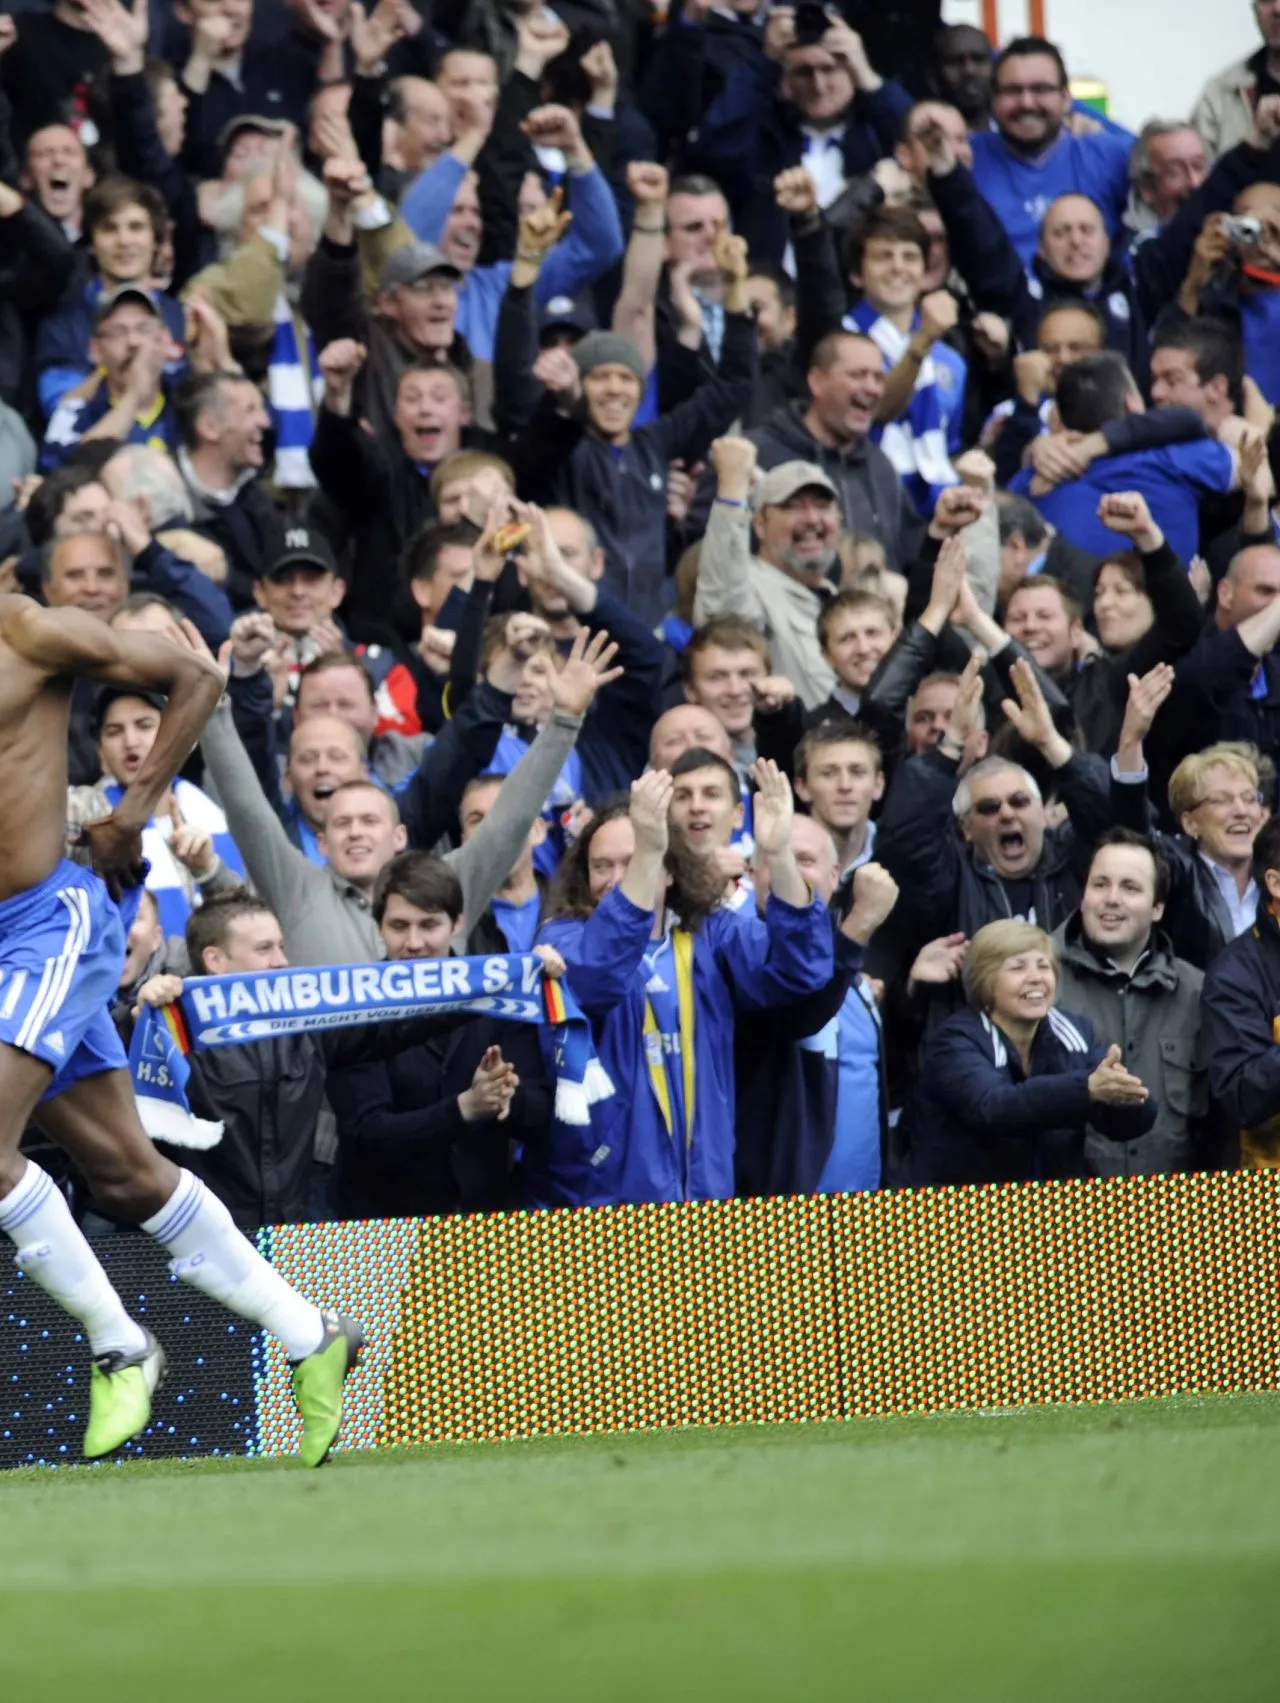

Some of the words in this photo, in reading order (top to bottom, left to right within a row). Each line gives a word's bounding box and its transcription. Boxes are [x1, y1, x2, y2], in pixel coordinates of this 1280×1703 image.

[191, 958, 471, 1023] HAMBURGER
[270, 1018, 297, 1030] DIE
[303, 1012, 361, 1028] MACHT
[367, 1008, 400, 1020] VON
[136, 1061, 175, 1087] H.S.
